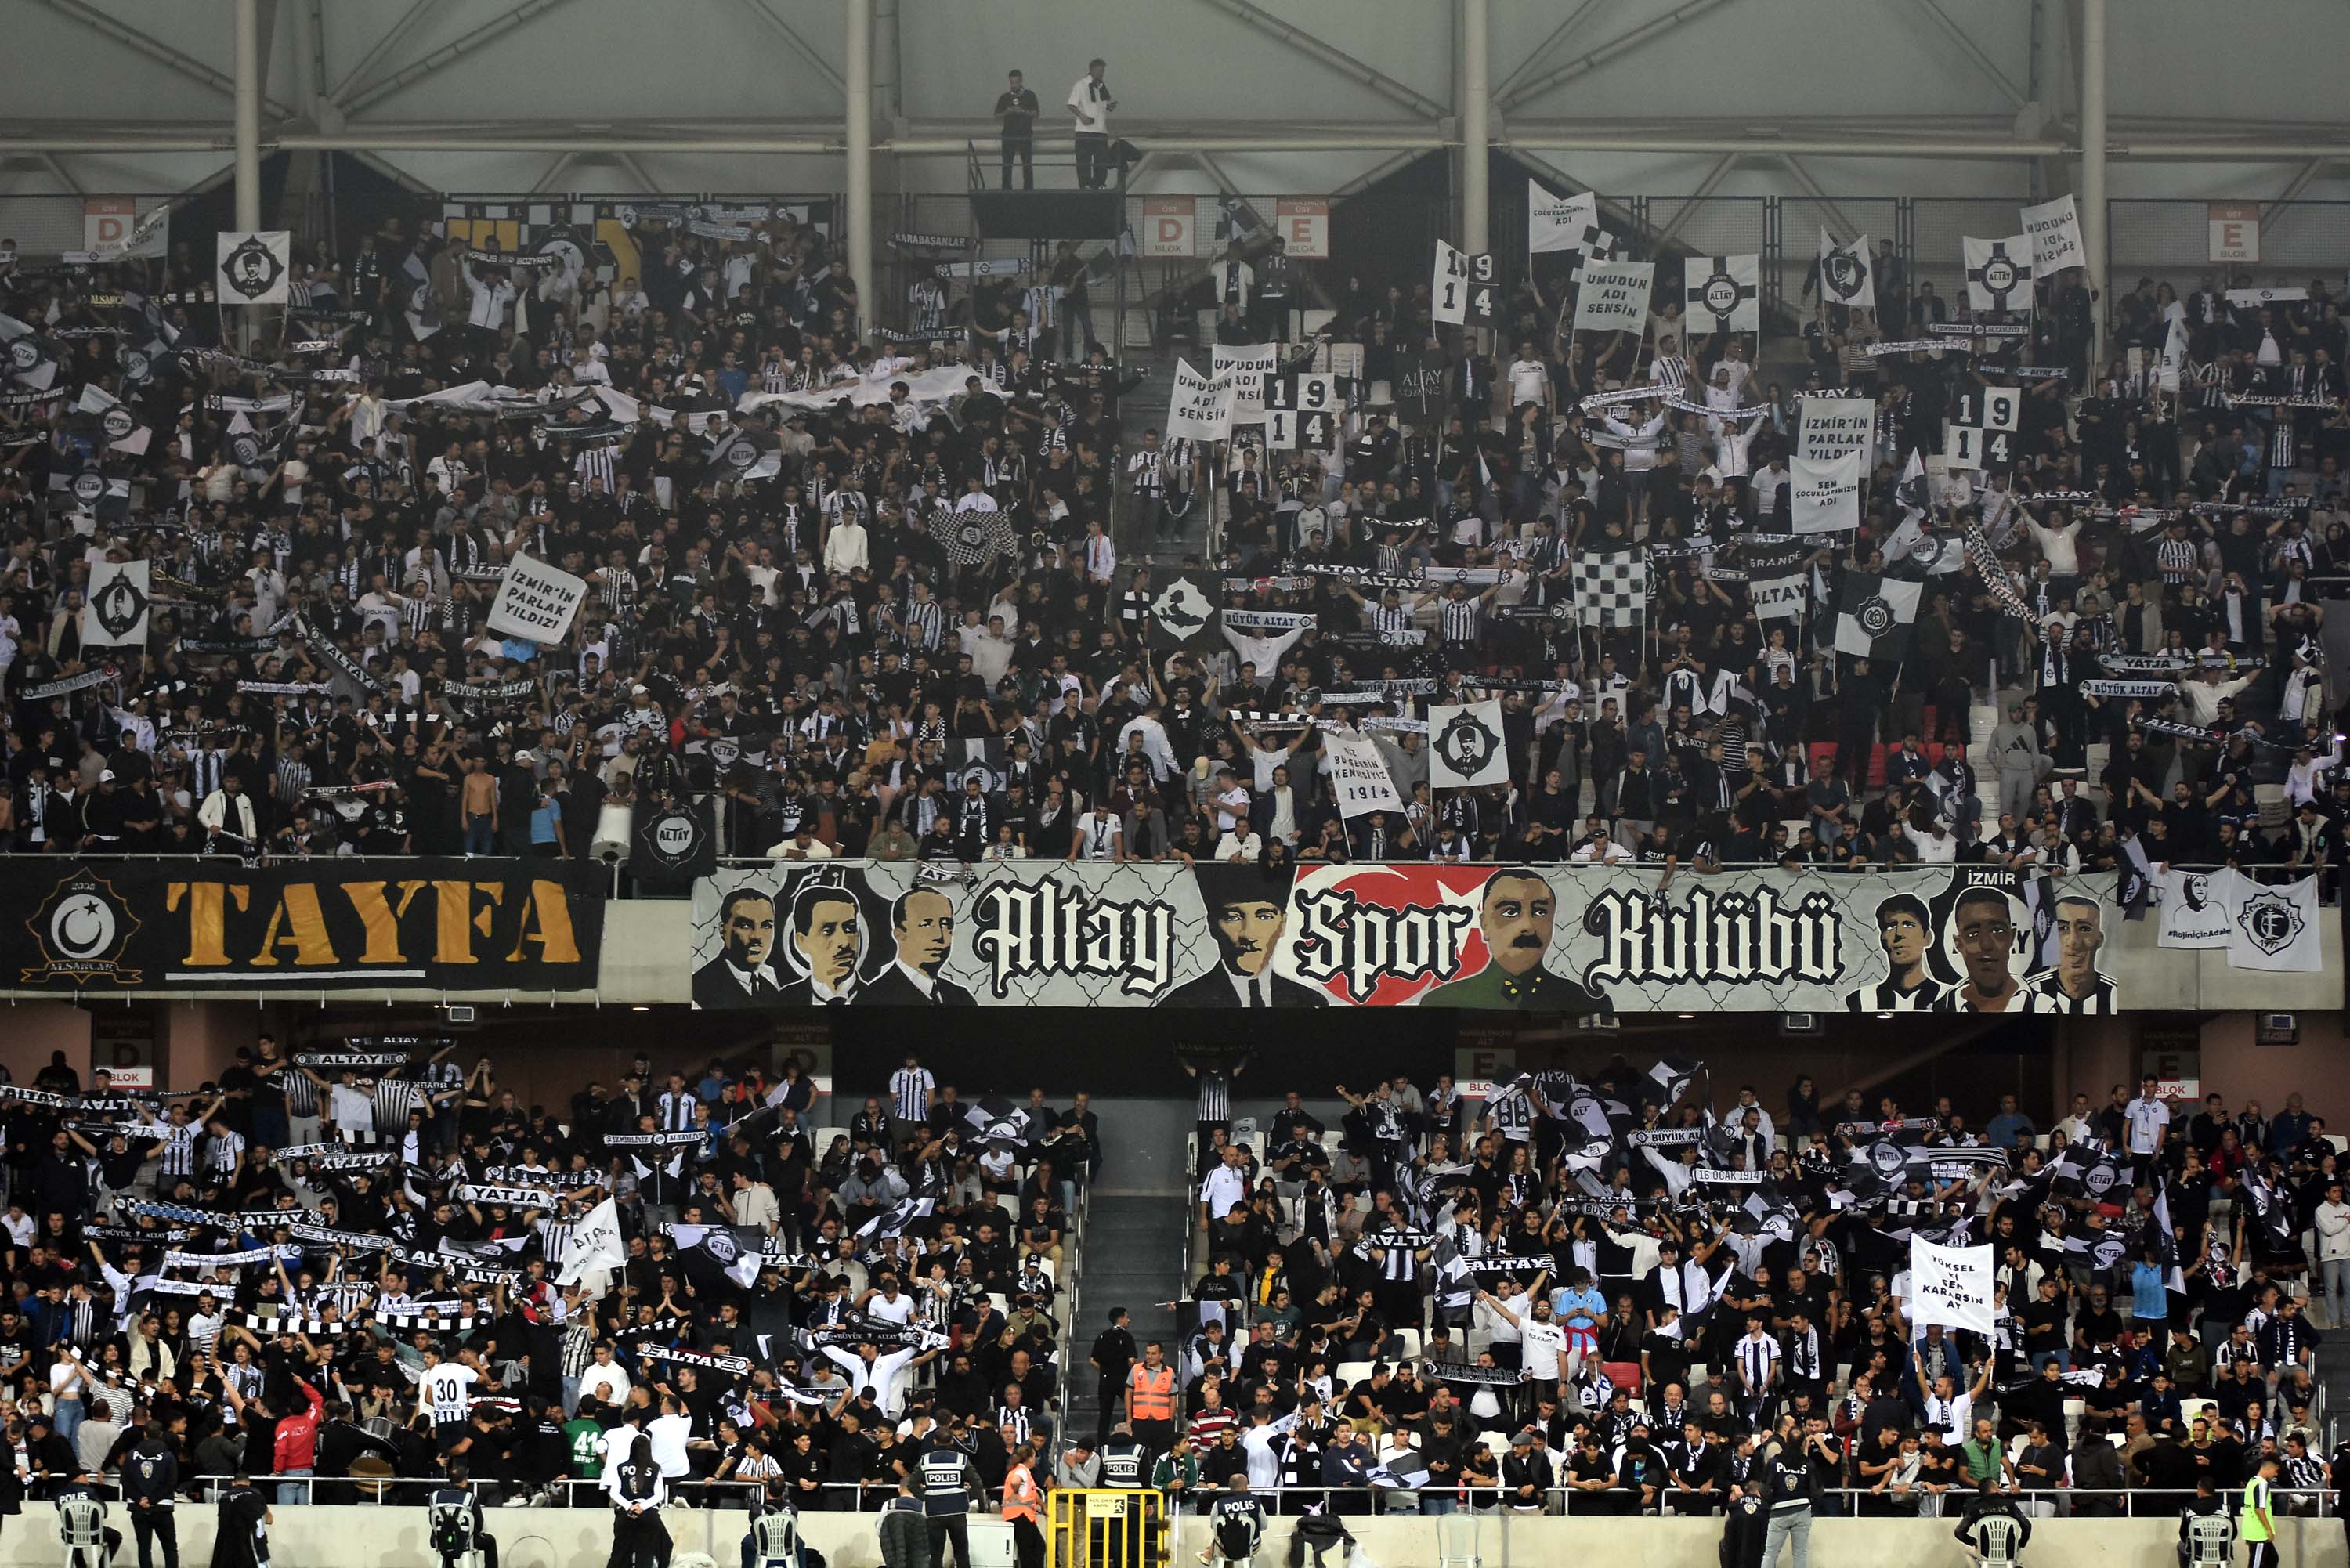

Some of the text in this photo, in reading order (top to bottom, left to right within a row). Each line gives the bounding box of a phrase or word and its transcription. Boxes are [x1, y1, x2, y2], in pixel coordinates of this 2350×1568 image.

[1555, 216, 1572, 227] ADI
[99, 219, 123, 242] D
[1159, 219, 1183, 242] D
[1292, 219, 1311, 242] E
[2224, 225, 2242, 247] E
[895, 233, 965, 247] KARABASANLAR
[1155, 244, 1183, 253] BLOK
[1289, 245, 1316, 254] BLOK
[1586, 273, 1648, 289] UMUDUN
[1988, 269, 2012, 281] ALTAY
[1601, 287, 1627, 300] ADI
[1709, 287, 1734, 302] ALTAY
[1586, 301, 1638, 318] SENSİN
[1179, 375, 1231, 393] UMUDUN
[1806, 415, 1867, 429] İZMİR'İN
[1808, 434, 1865, 445] PARLAK
[730, 449, 755, 461] ALTAY
[1810, 449, 1864, 461] YILDI
[1817, 481, 1838, 490] SEN
[1819, 497, 1837, 507] ADI
[2032, 490, 2094, 500] ALTAY
[1911, 542, 1936, 555] ALTAY
[1750, 551, 1802, 568] GRANDE
[465, 563, 508, 577] ALTA
[1303, 563, 1371, 576] ALTAY
[511, 568, 576, 603] İZMİR'İN
[1359, 576, 1423, 589] ALTAY
[1752, 583, 1806, 605] ALTAY
[507, 587, 566, 616] PARLAK
[504, 601, 558, 629] YILDIZI
[1226, 613, 1296, 627] BÜYÜK ALTAY
[498, 679, 533, 697] ALTAY
[2094, 684, 2160, 695] BÜYÜK ALTAY
[2144, 717, 2207, 739] ALTAY
[712, 746, 737, 757] ALTAY
[1459, 764, 1477, 773] 1914
[1348, 786, 1390, 800] 1914
[659, 826, 691, 842] ALTAY
[1967, 868, 2016, 887] İZMİR
[165, 879, 583, 966] TAYFA
[1299, 889, 1470, 1000] Spor
[1587, 886, 1845, 995] Kulübü
[113, 1043, 140, 1069] D
[321, 1054, 381, 1064] ALTAY
[1473, 1053, 1495, 1079] E
[2157, 1055, 2180, 1080] E
[111, 1072, 139, 1082] BLOK
[1469, 1083, 1491, 1092] BLO
[2157, 1086, 2186, 1094] BLOK
[7, 1088, 56, 1104] ALTAY
[80, 1098, 129, 1111] LTAY
[1699, 1170, 1759, 1182] 16 OCAK 1914
[2088, 1173, 2112, 1186] ALTAY
[244, 1212, 303, 1226] ALTAY
[146, 1231, 165, 1240] ALTAY
[313, 1228, 371, 1245] ALTAY
[763, 1253, 804, 1266] TAY
[1471, 1258, 1546, 1272] ALTAY
[464, 1270, 521, 1284] ALTAY
[1946, 1300, 1961, 1310] AY
[836, 1332, 898, 1341] BÜYÜK ALTAY
[1527, 1334, 1554, 1344] FOLKART
[657, 1347, 727, 1368] ALTAY
[436, 1378, 457, 1402] 30
[574, 1430, 598, 1451] 41
[621, 1465, 653, 1477] POS
[1105, 1464, 1134, 1474] POLİS
[928, 1472, 957, 1483] POLİS
[1224, 1498, 1255, 1514] POLİS
